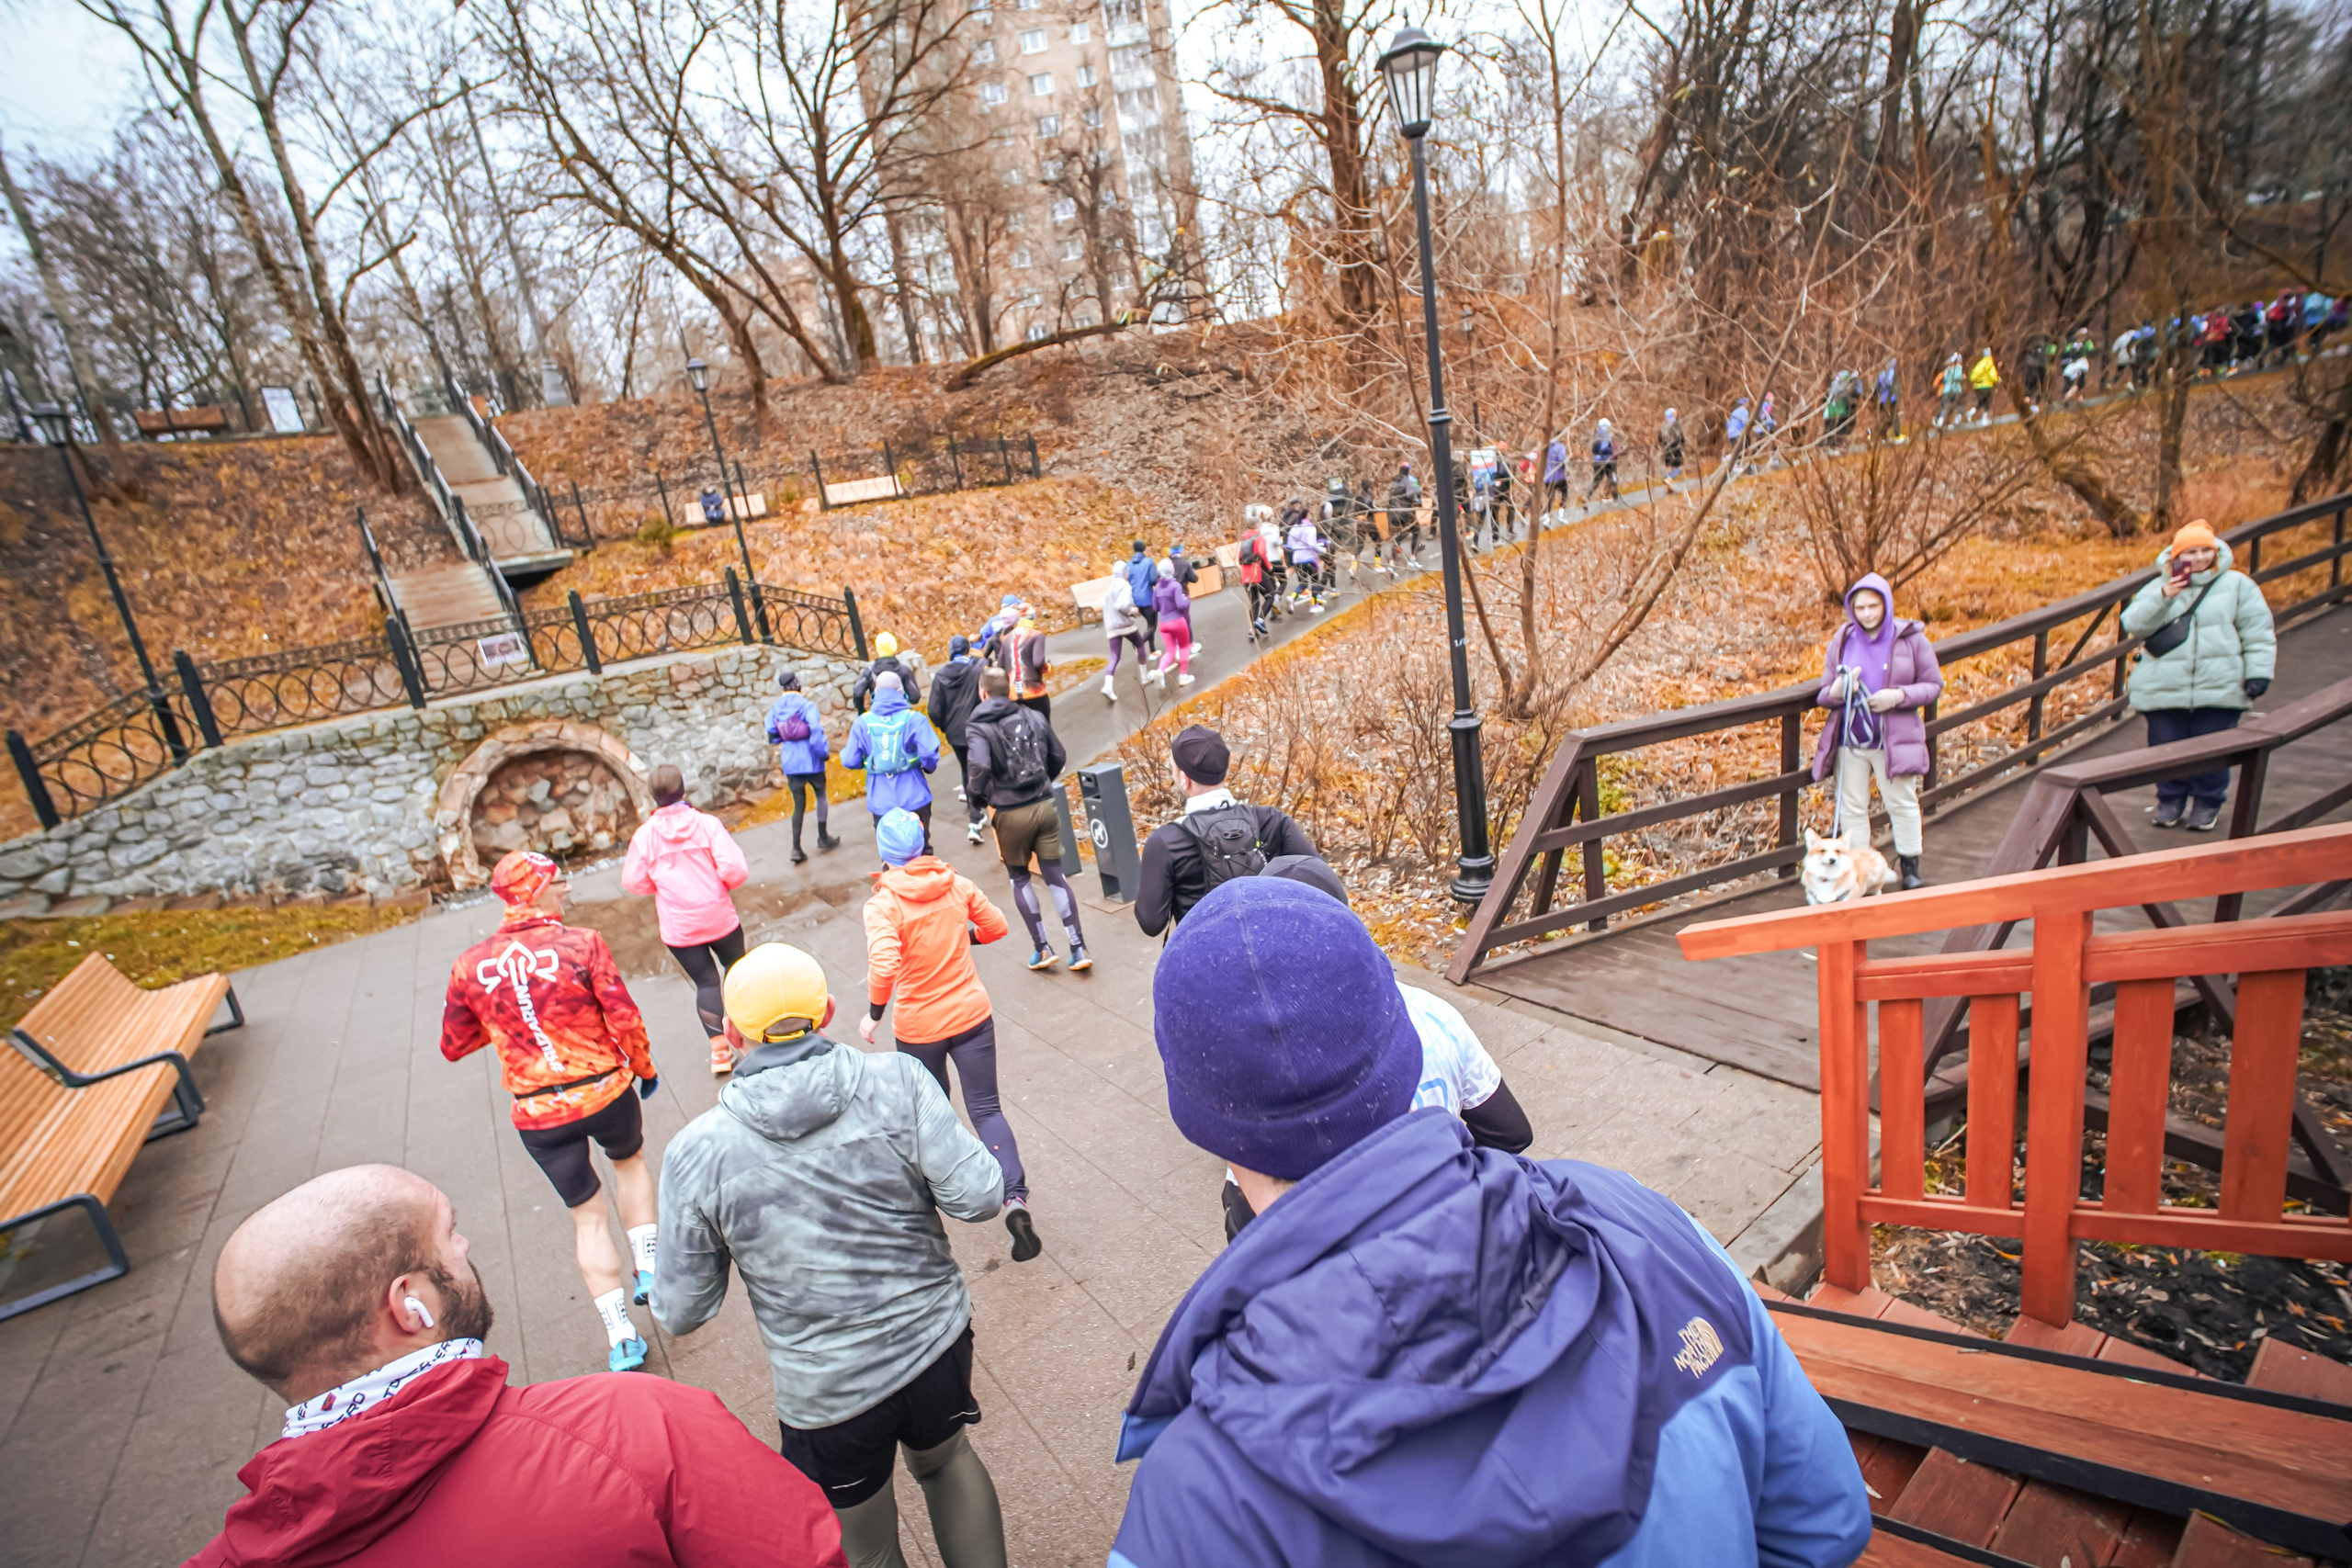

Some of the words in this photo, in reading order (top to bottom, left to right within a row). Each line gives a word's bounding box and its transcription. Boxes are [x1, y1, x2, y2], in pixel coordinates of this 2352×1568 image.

[1678, 1321, 1701, 1346] THE
[1673, 1336, 1710, 1372] NORTH
[1690, 1348, 1714, 1379] FACE
